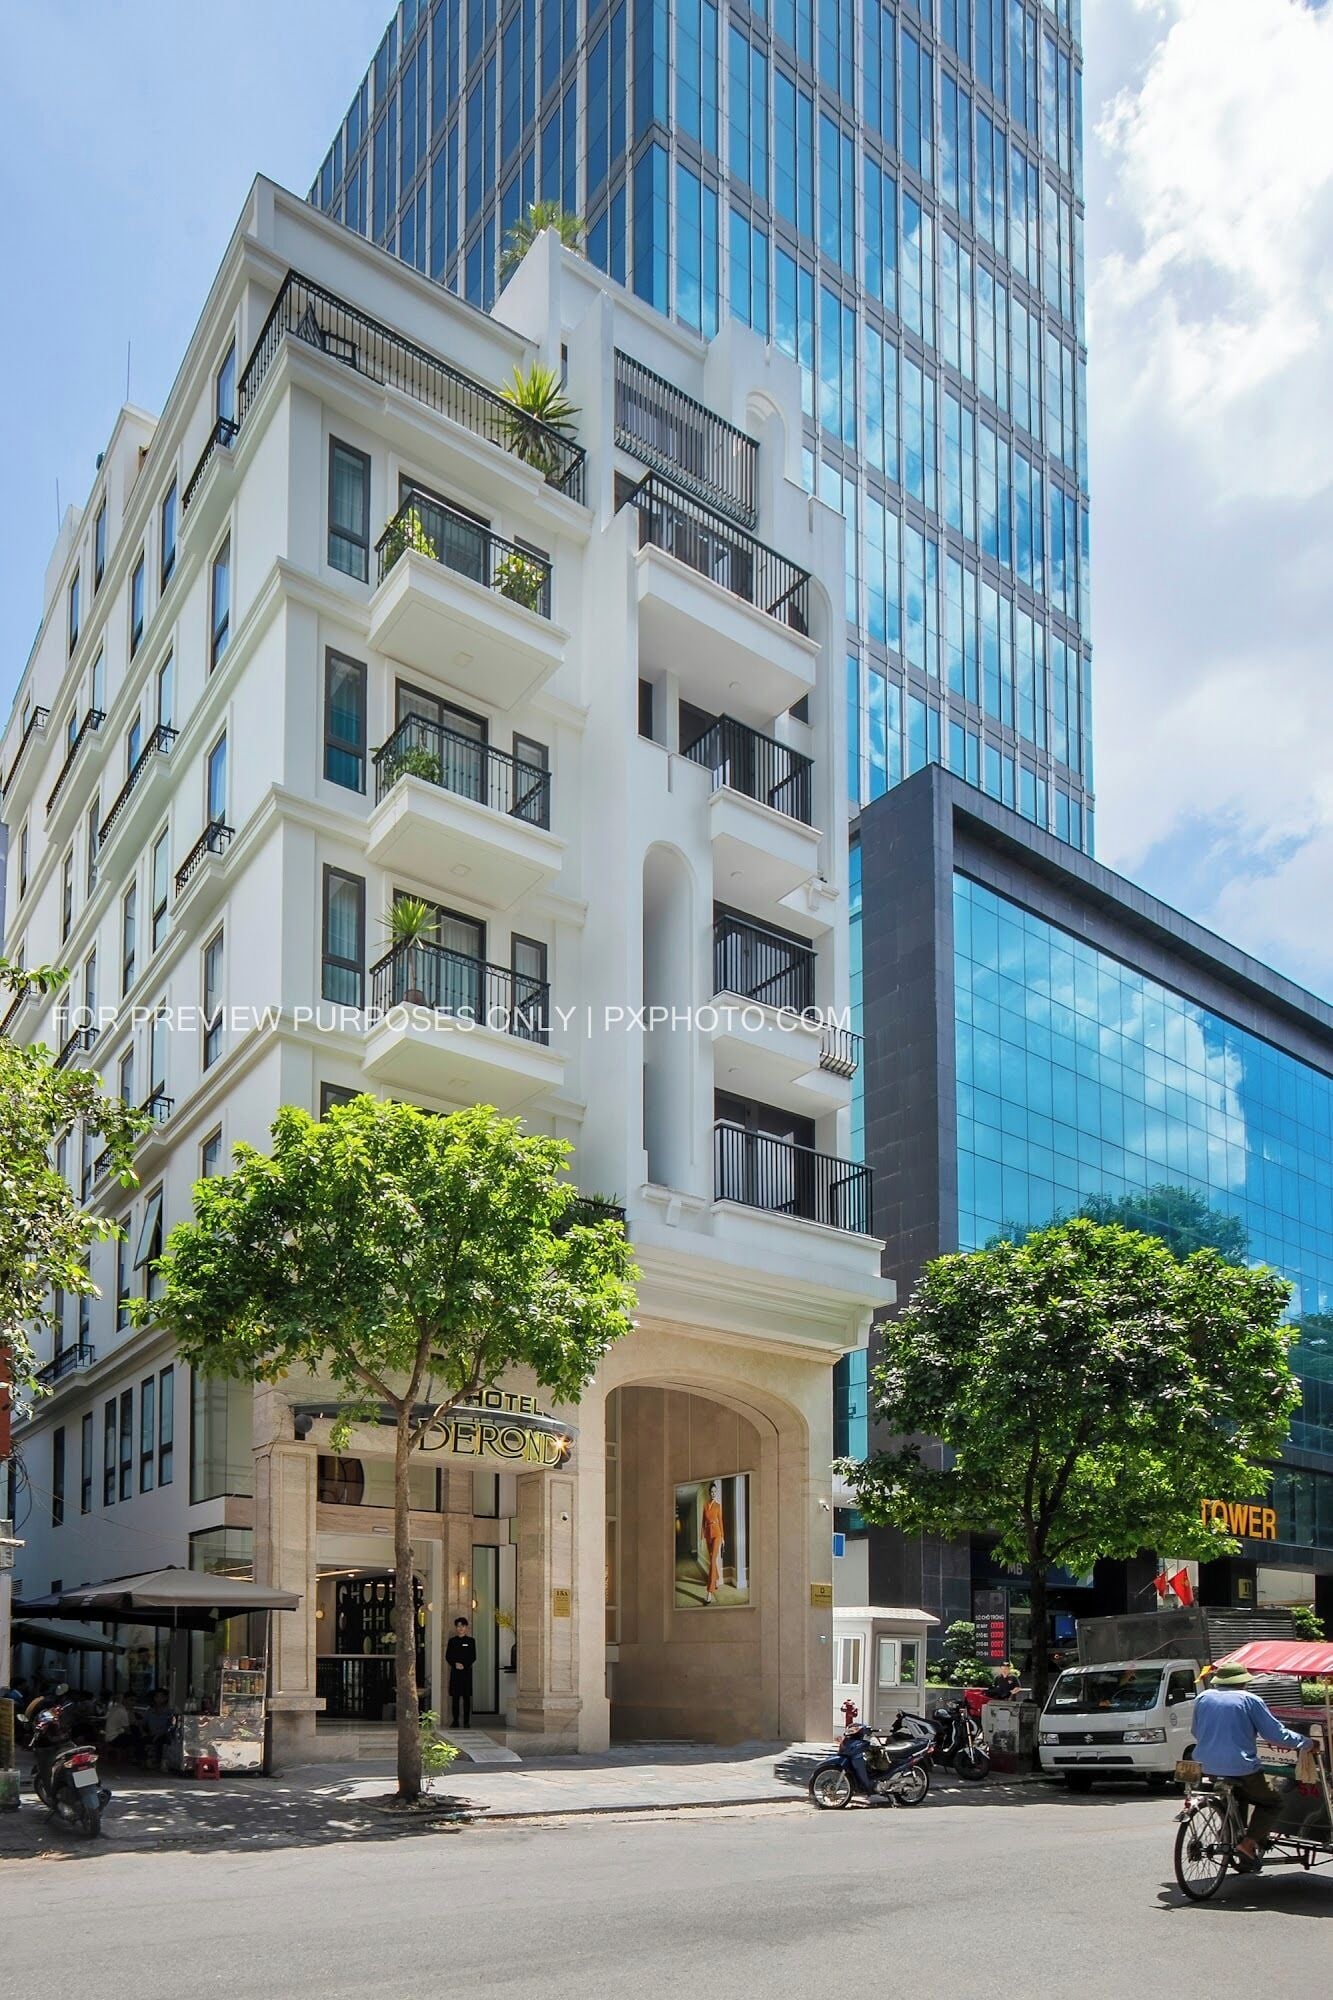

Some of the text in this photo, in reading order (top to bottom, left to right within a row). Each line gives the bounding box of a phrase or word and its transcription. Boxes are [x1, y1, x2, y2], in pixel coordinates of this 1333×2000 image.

[463, 1389, 544, 1417] HOTEL
[417, 1416, 563, 1466] DEROND
[1200, 1498, 1277, 1540] TOWER
[1007, 1561, 1023, 1575] MB
